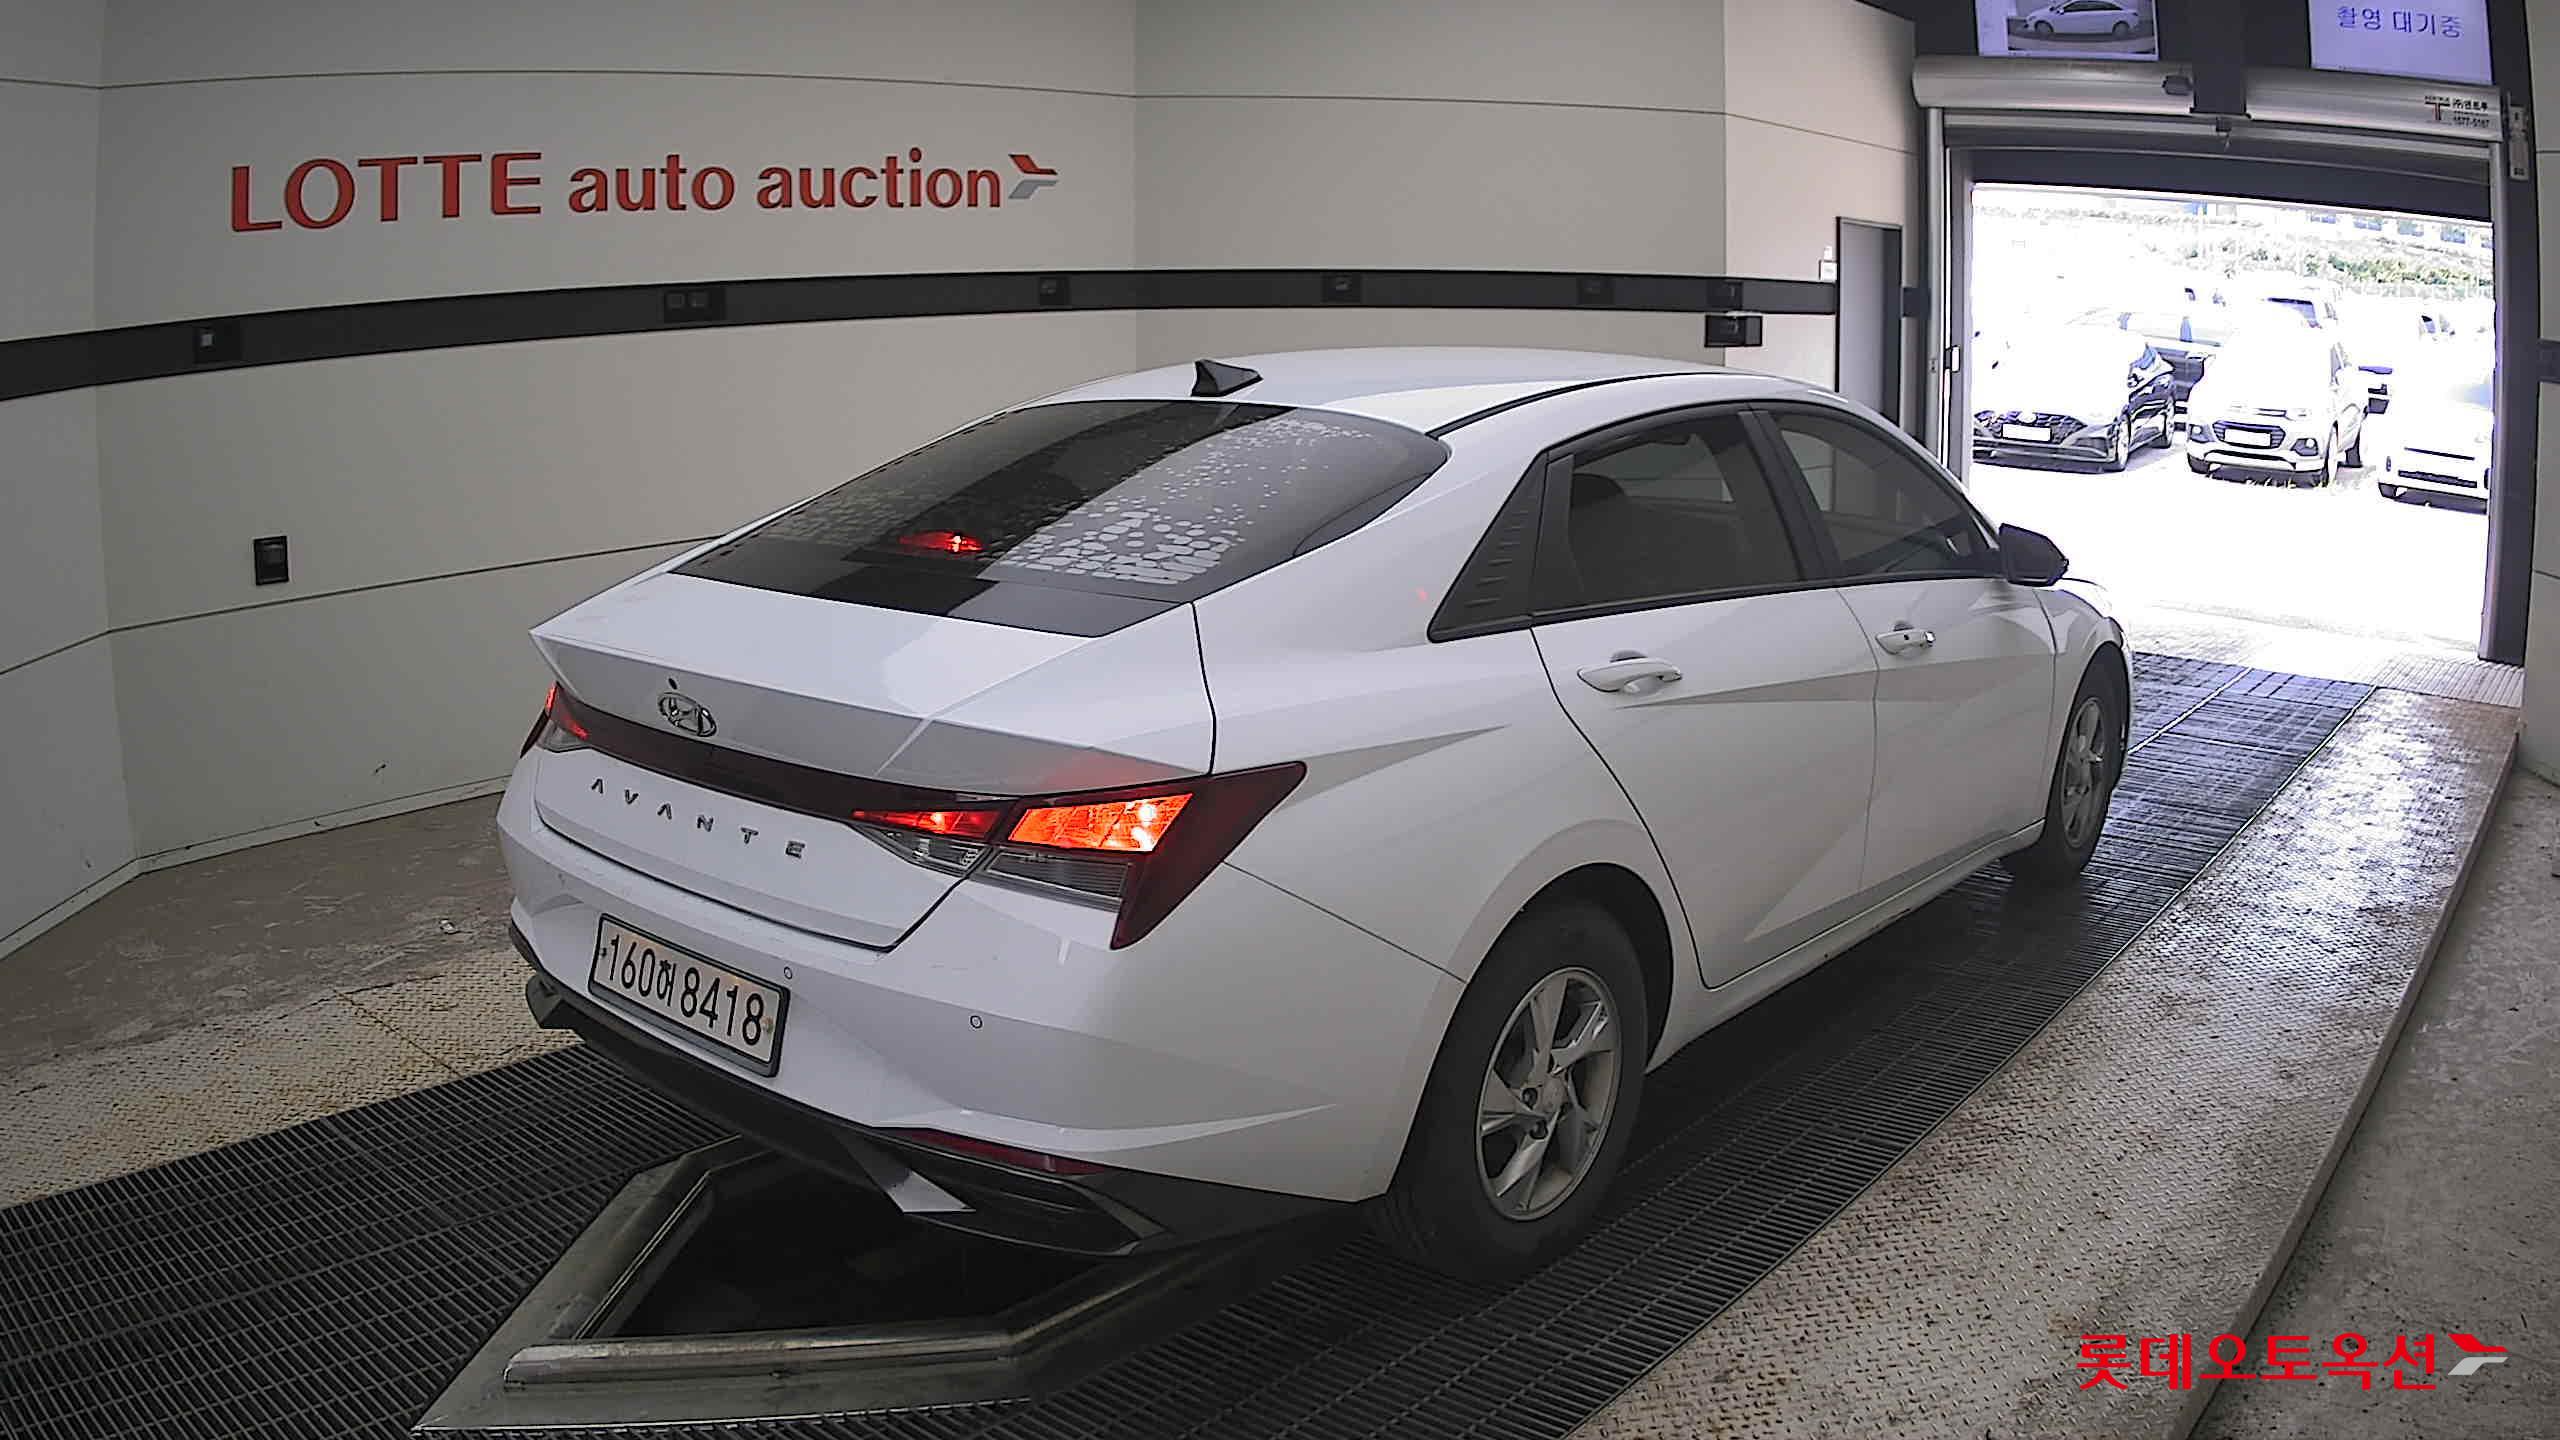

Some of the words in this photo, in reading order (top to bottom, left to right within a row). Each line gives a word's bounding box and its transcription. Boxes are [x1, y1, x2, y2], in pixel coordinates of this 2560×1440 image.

[2337, 6, 2382, 29] 촬영
[2392, 10, 2463, 38] 대기중
[230, 151, 543, 232] LOTTE
[568, 153, 736, 213] auto
[756, 147, 1002, 209] auction
[590, 776, 806, 859] AVANTE
